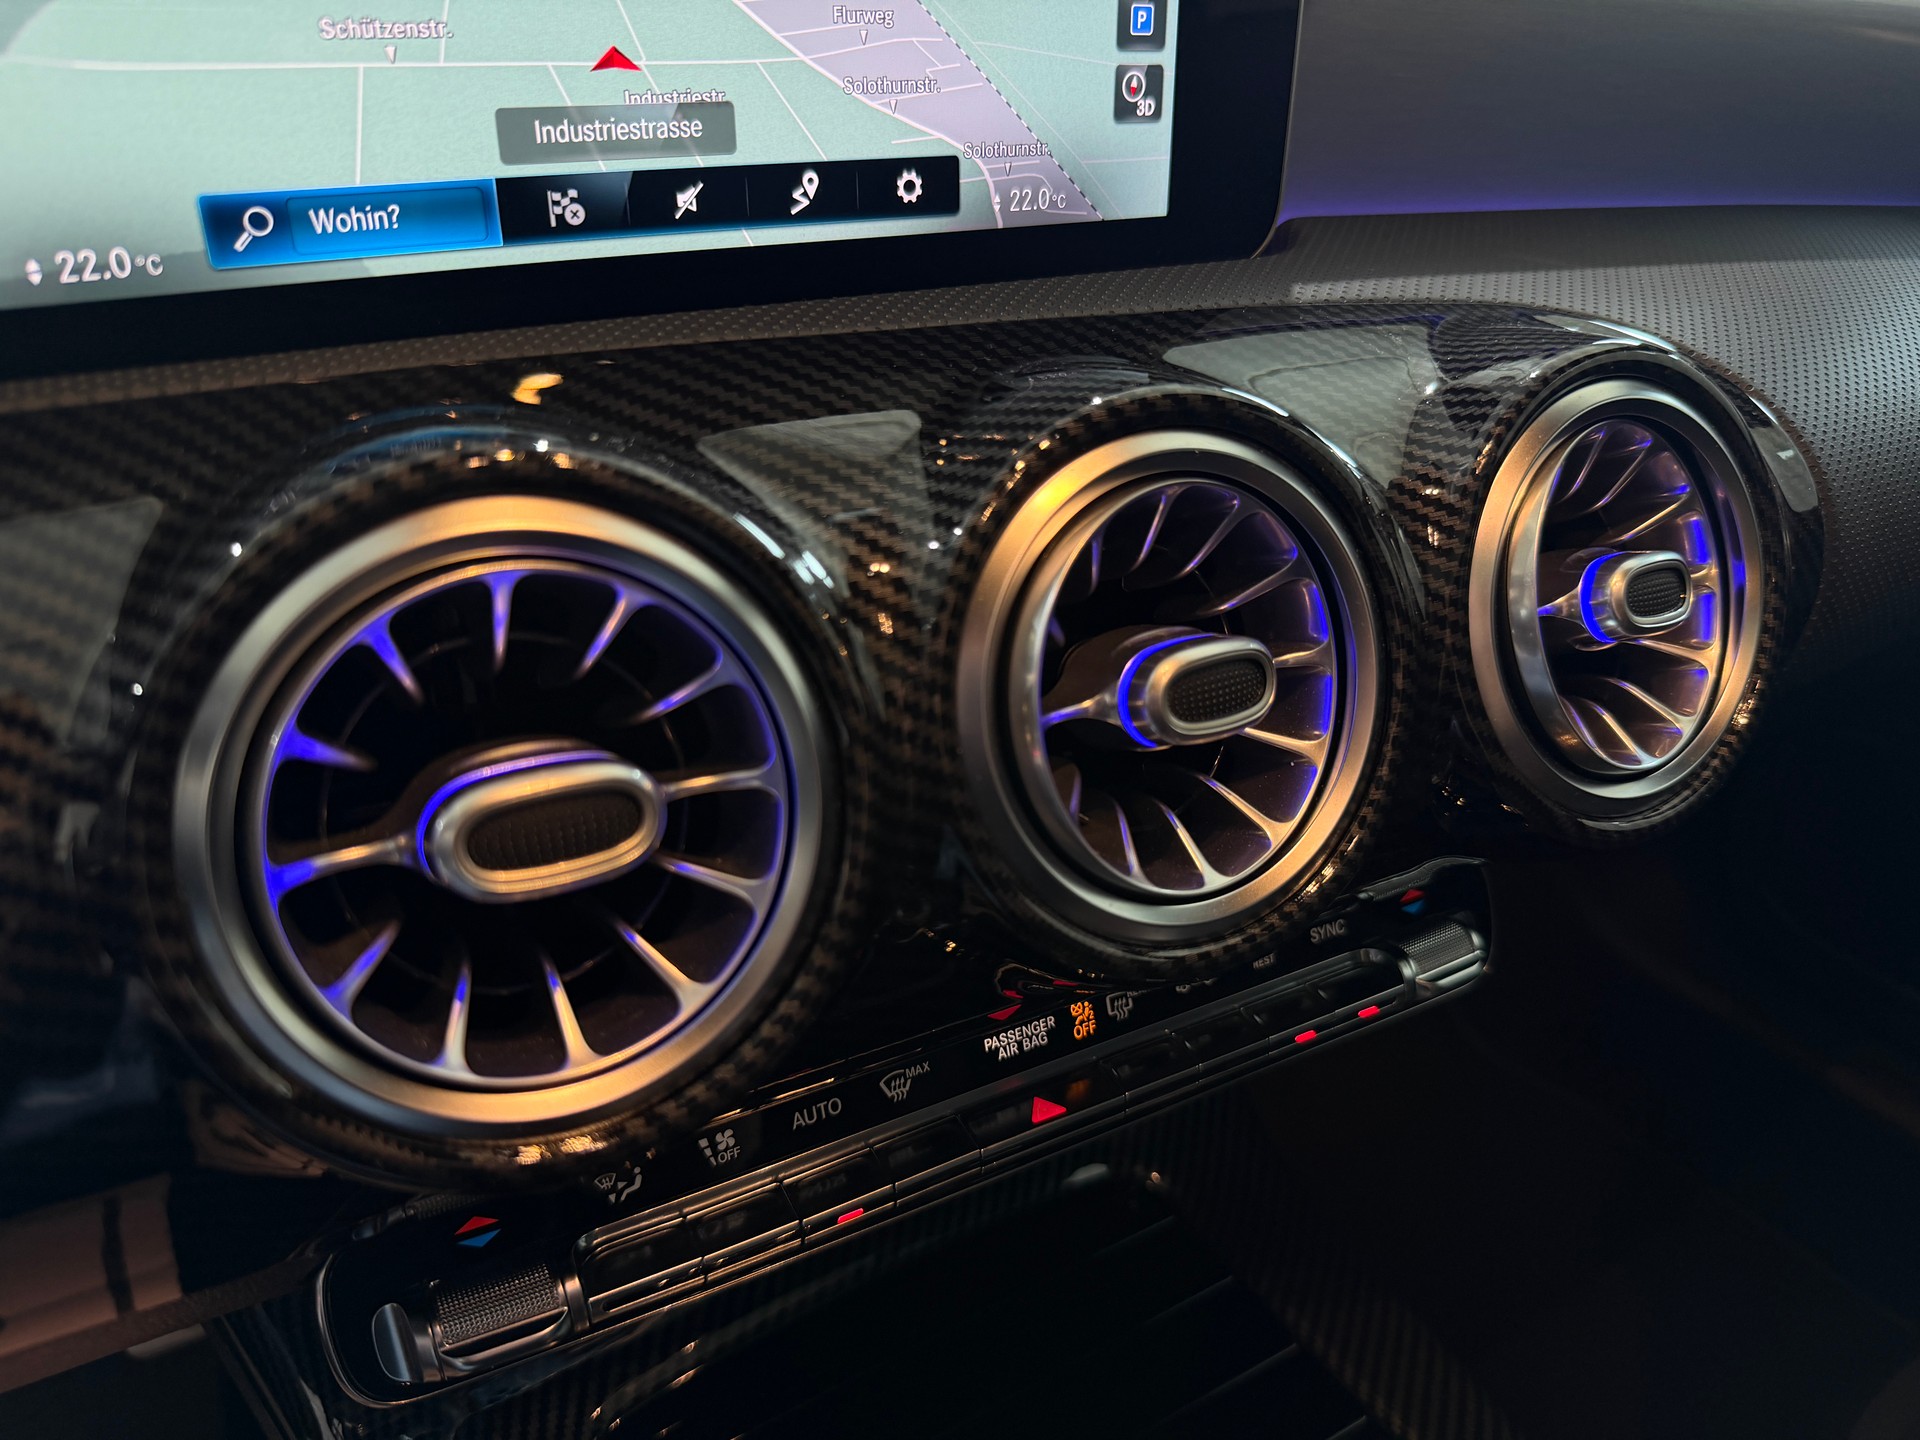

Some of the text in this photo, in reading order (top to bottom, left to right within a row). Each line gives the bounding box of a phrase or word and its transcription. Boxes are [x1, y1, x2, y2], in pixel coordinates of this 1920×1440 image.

[318, 17, 454, 42] Schützenstr.
[832, 6, 895, 29] Flurweg
[842, 76, 942, 96] Solothurnstr.
[1136, 100, 1155, 117] 3D
[533, 116, 704, 145] Industriestrasse
[963, 141, 1052, 159] Solothurnstr.
[308, 203, 402, 236] Wohin?
[1310, 919, 1347, 944] SYNC
[984, 1016, 1056, 1053] PASSENGER
[1073, 1020, 1097, 1040] OFF
[998, 1032, 1048, 1061] AIR BAG
[905, 1061, 930, 1079] MAX
[792, 1097, 842, 1131] AUTO
[717, 1146, 741, 1164] OFF
